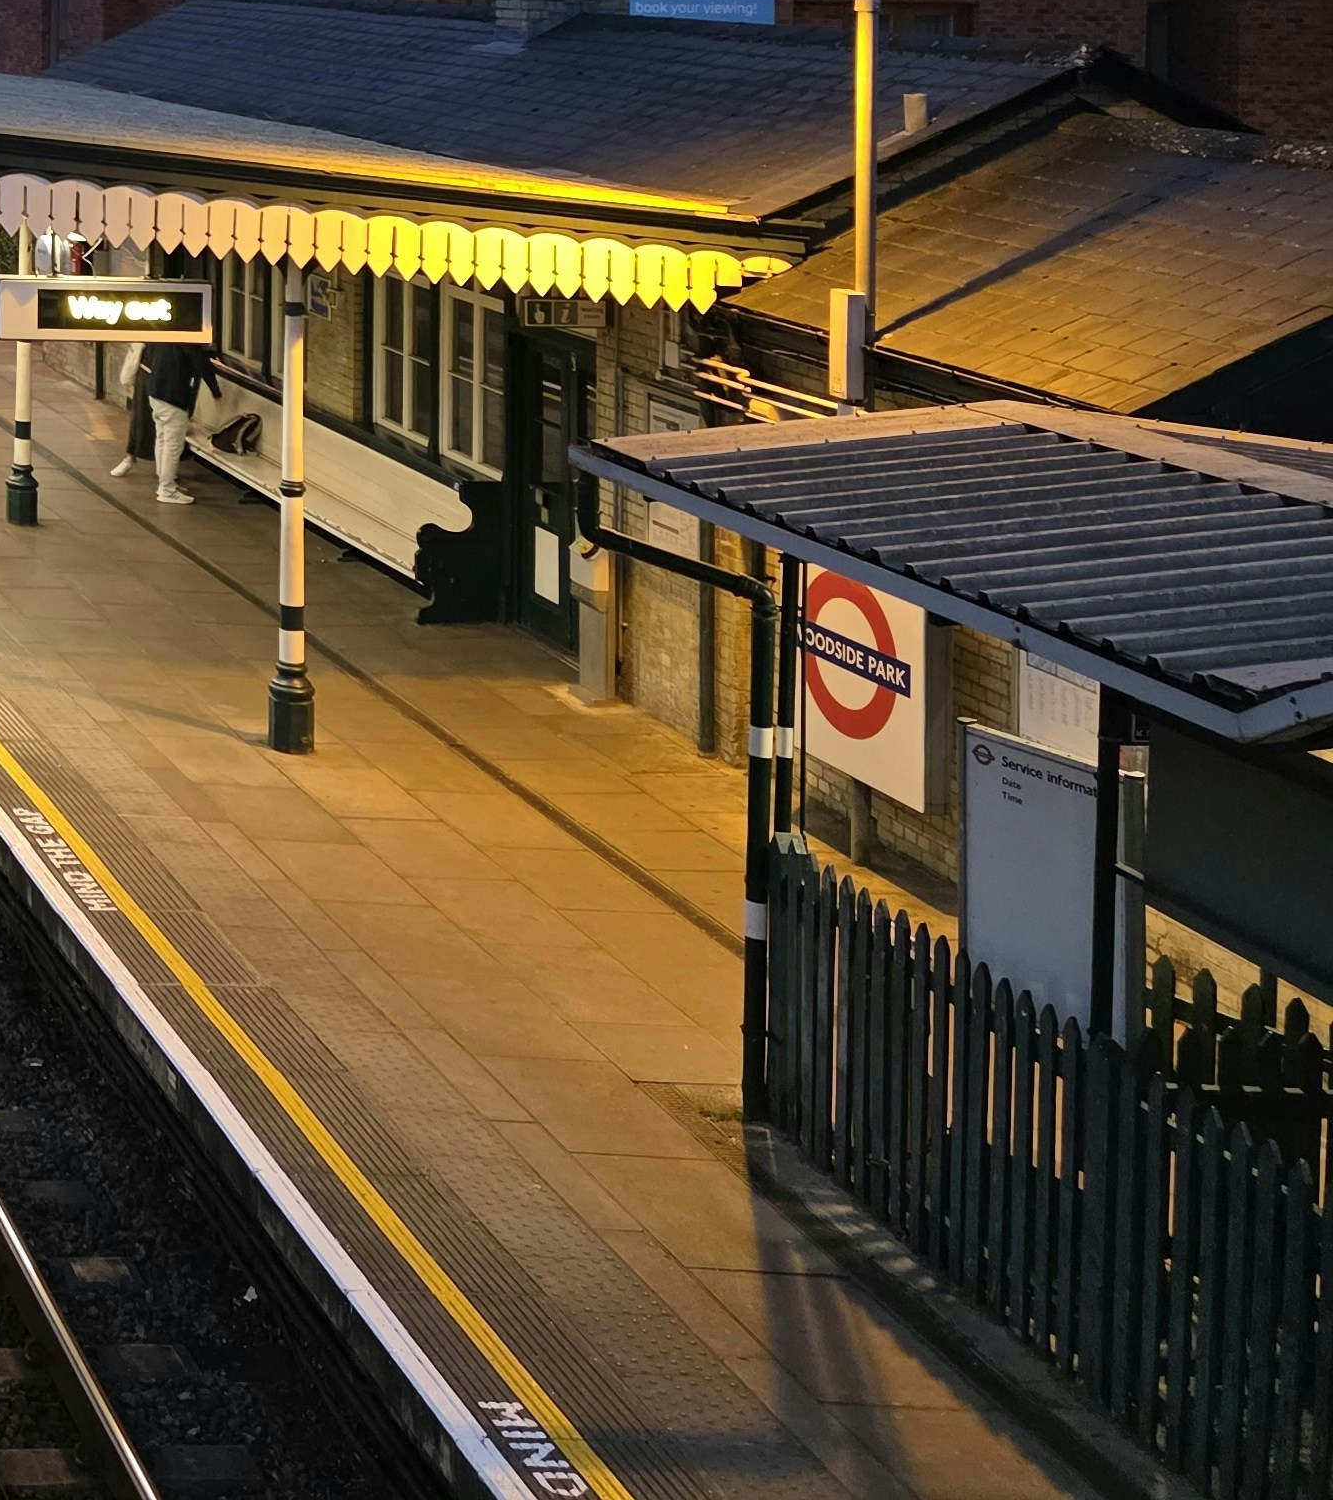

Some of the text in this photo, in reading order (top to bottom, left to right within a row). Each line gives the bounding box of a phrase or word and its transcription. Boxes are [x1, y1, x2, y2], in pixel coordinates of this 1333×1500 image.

[635, 1, 758, 17] book your viewing!
[68, 296, 172, 325] Way out
[868, 655, 906, 689] PARK
[1002, 756, 1043, 780] Service
[1002, 777, 1022, 790] Date
[1002, 791, 1023, 805] Time
[12, 807, 119, 912] MIND THE GAP
[478, 1401, 589, 1497] MIND
